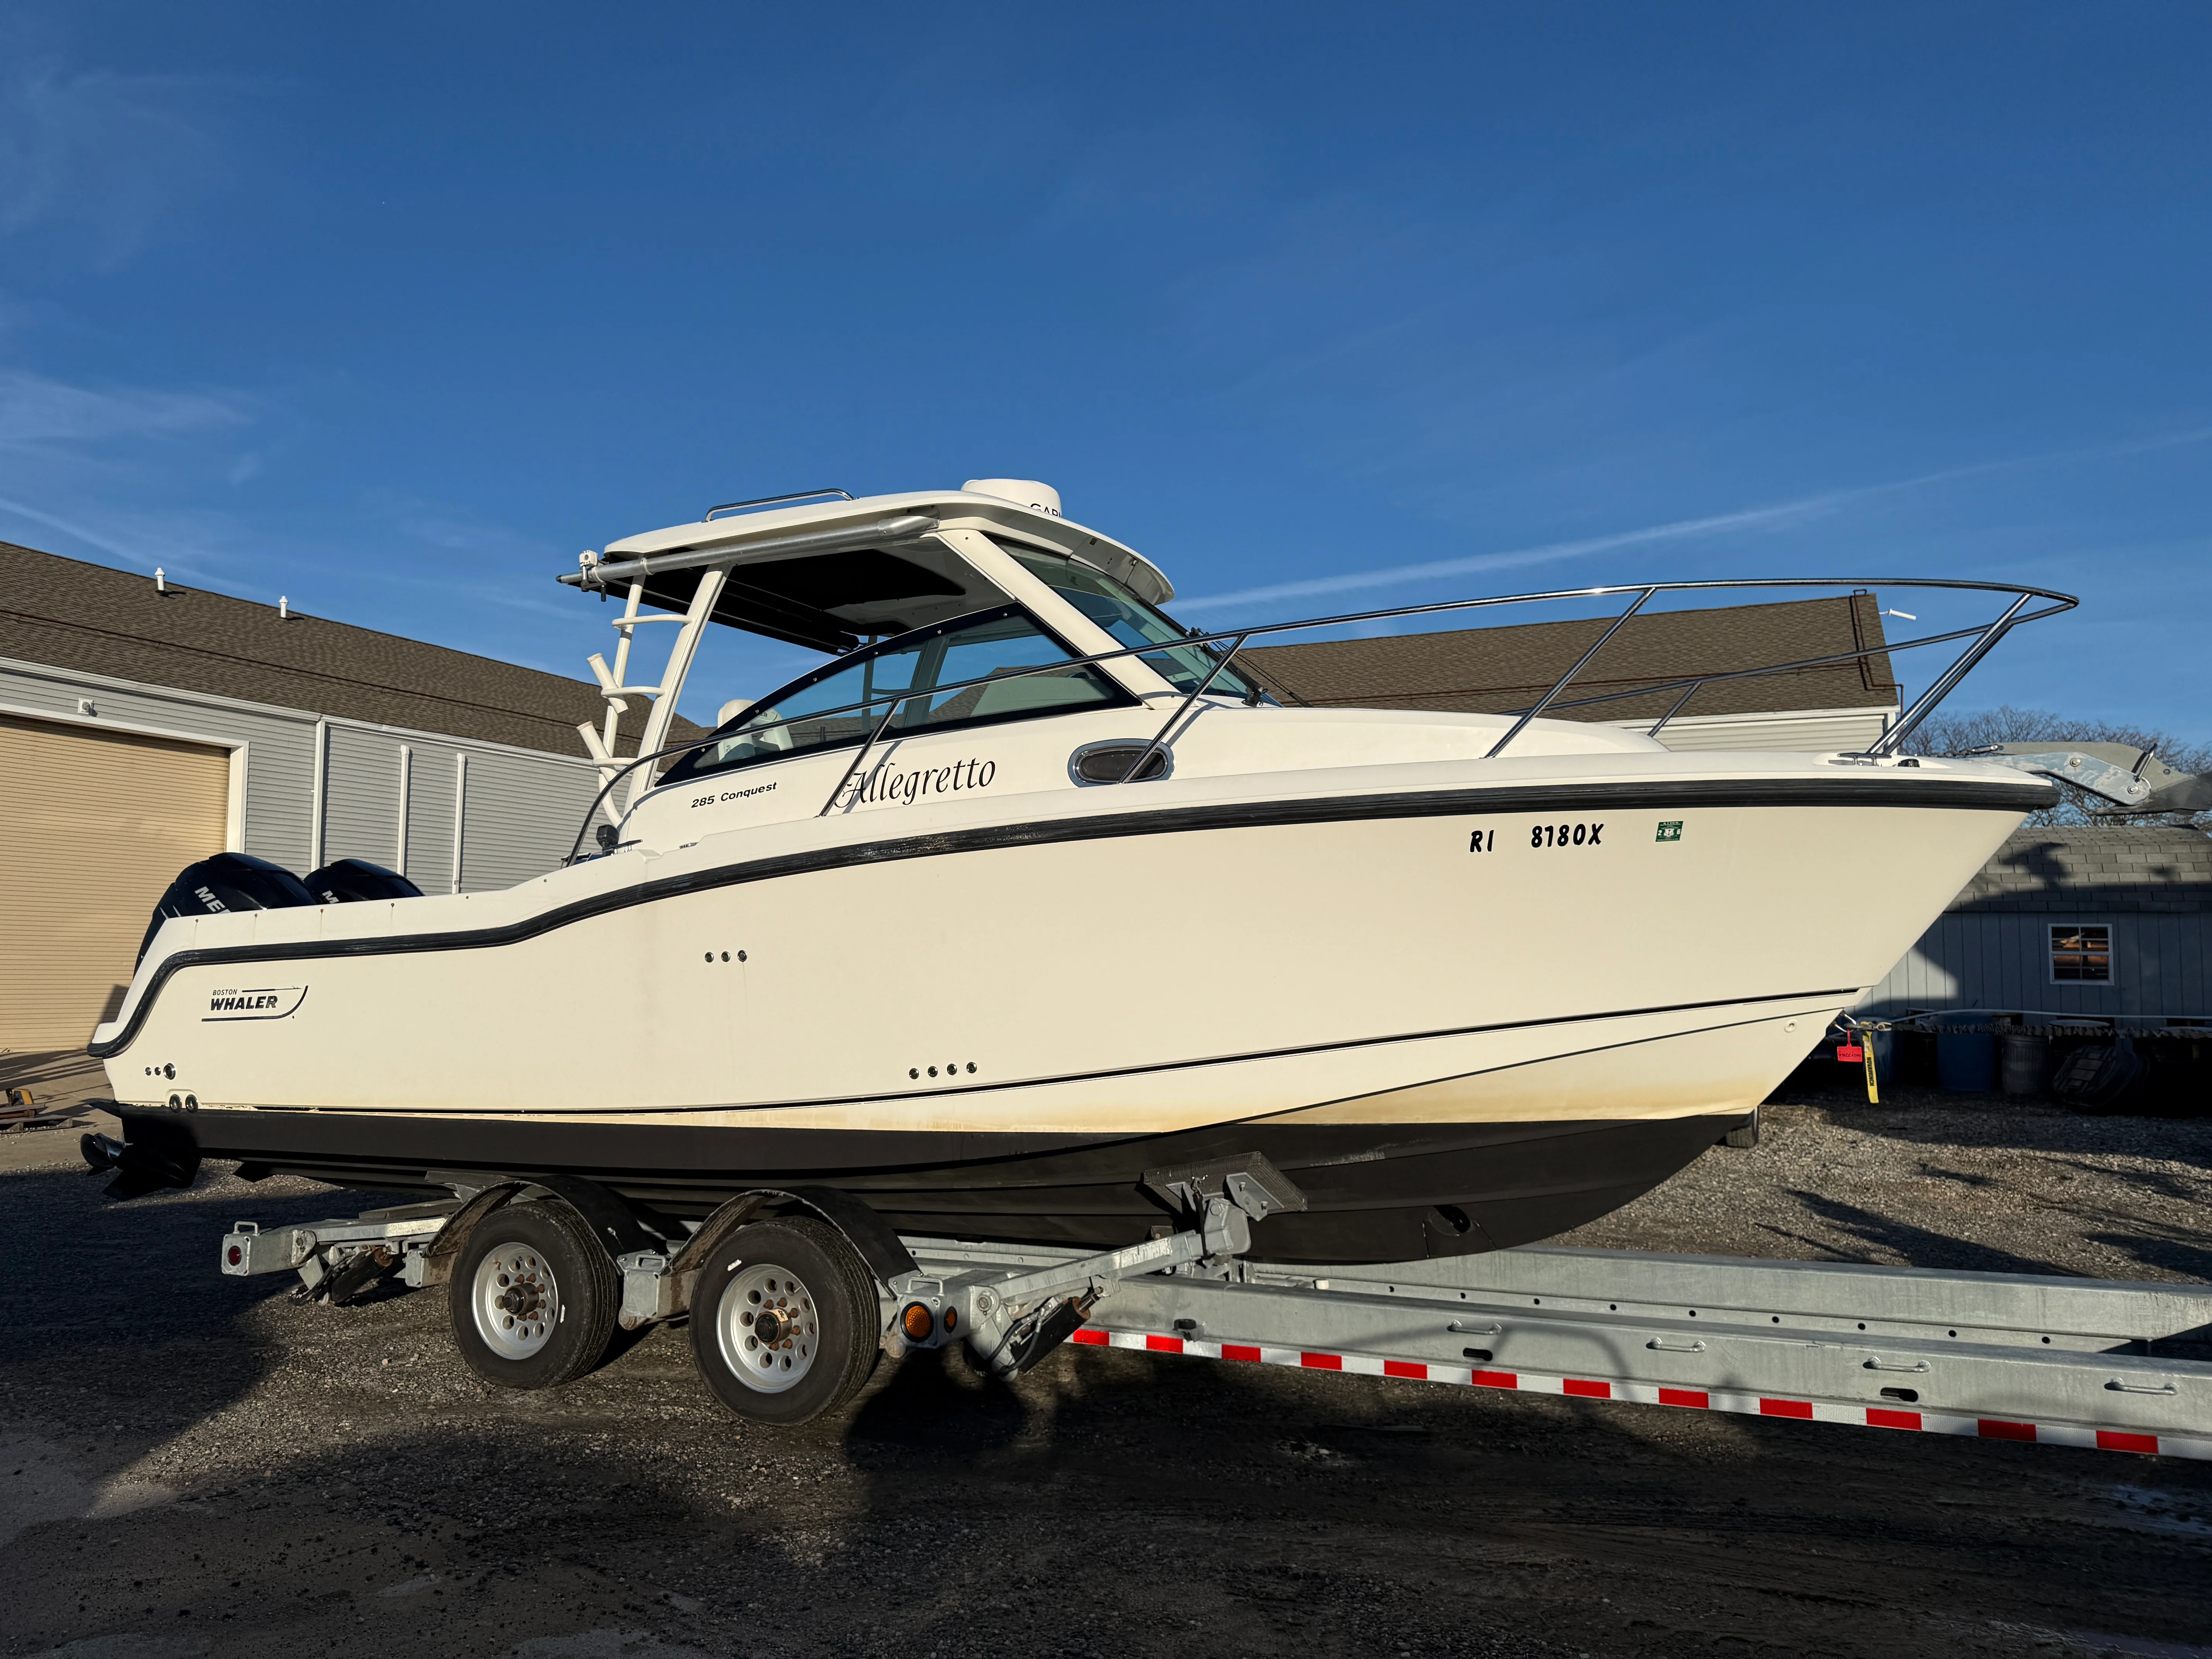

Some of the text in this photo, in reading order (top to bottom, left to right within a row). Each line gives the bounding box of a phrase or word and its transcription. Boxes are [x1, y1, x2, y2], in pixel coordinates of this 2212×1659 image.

[1030, 503, 1062, 518] GAR
[691, 781, 777, 808] 285 Conquest
[834, 757, 996, 808] Allegretto
[1470, 823, 1604, 852] RI 8180X
[210, 995, 278, 1011] WHALER
